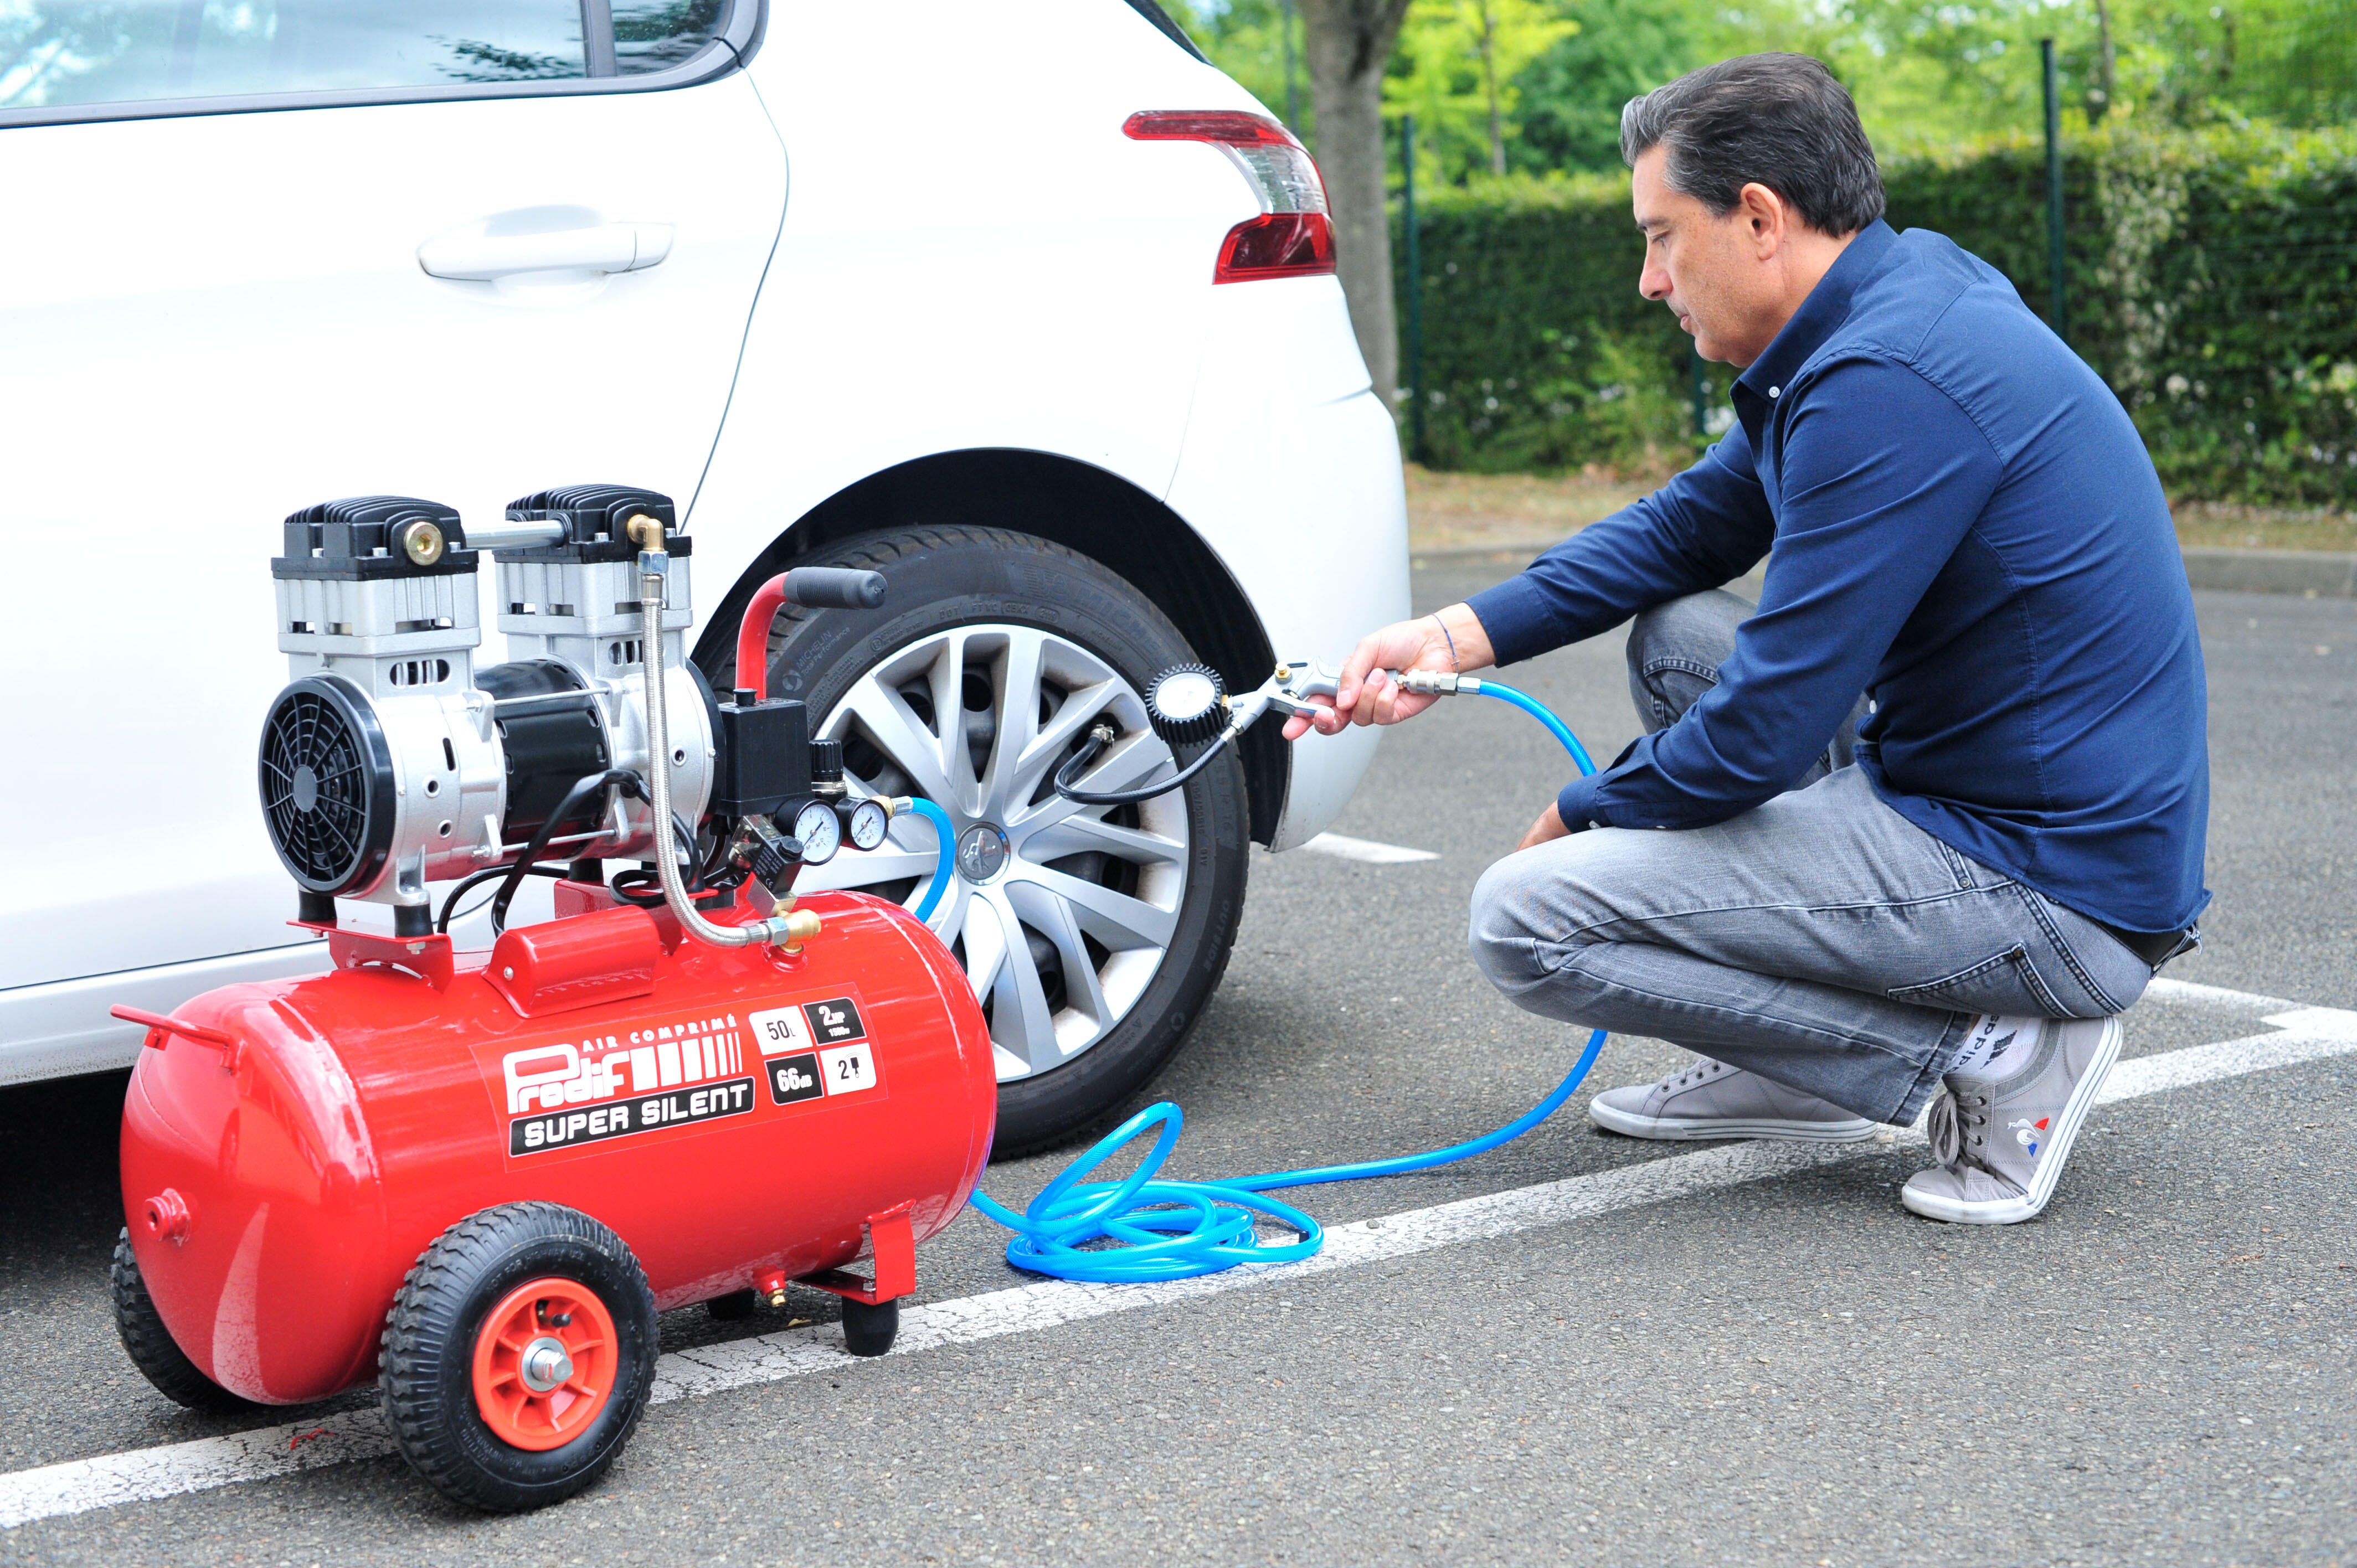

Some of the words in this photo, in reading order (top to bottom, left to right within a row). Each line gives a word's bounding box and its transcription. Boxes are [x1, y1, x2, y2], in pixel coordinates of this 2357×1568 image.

[796, 630, 832, 669] MICHELIN
[583, 1036, 618, 1053] AIR
[630, 1013, 737, 1044] COMPRIMÉ
[1947, 1015, 2000, 1073] adidas
[838, 1060, 849, 1080] 2
[524, 1106, 629, 1148] SUPER
[641, 1084, 748, 1126] SILENT
[504, 1258, 523, 1273] FOR
